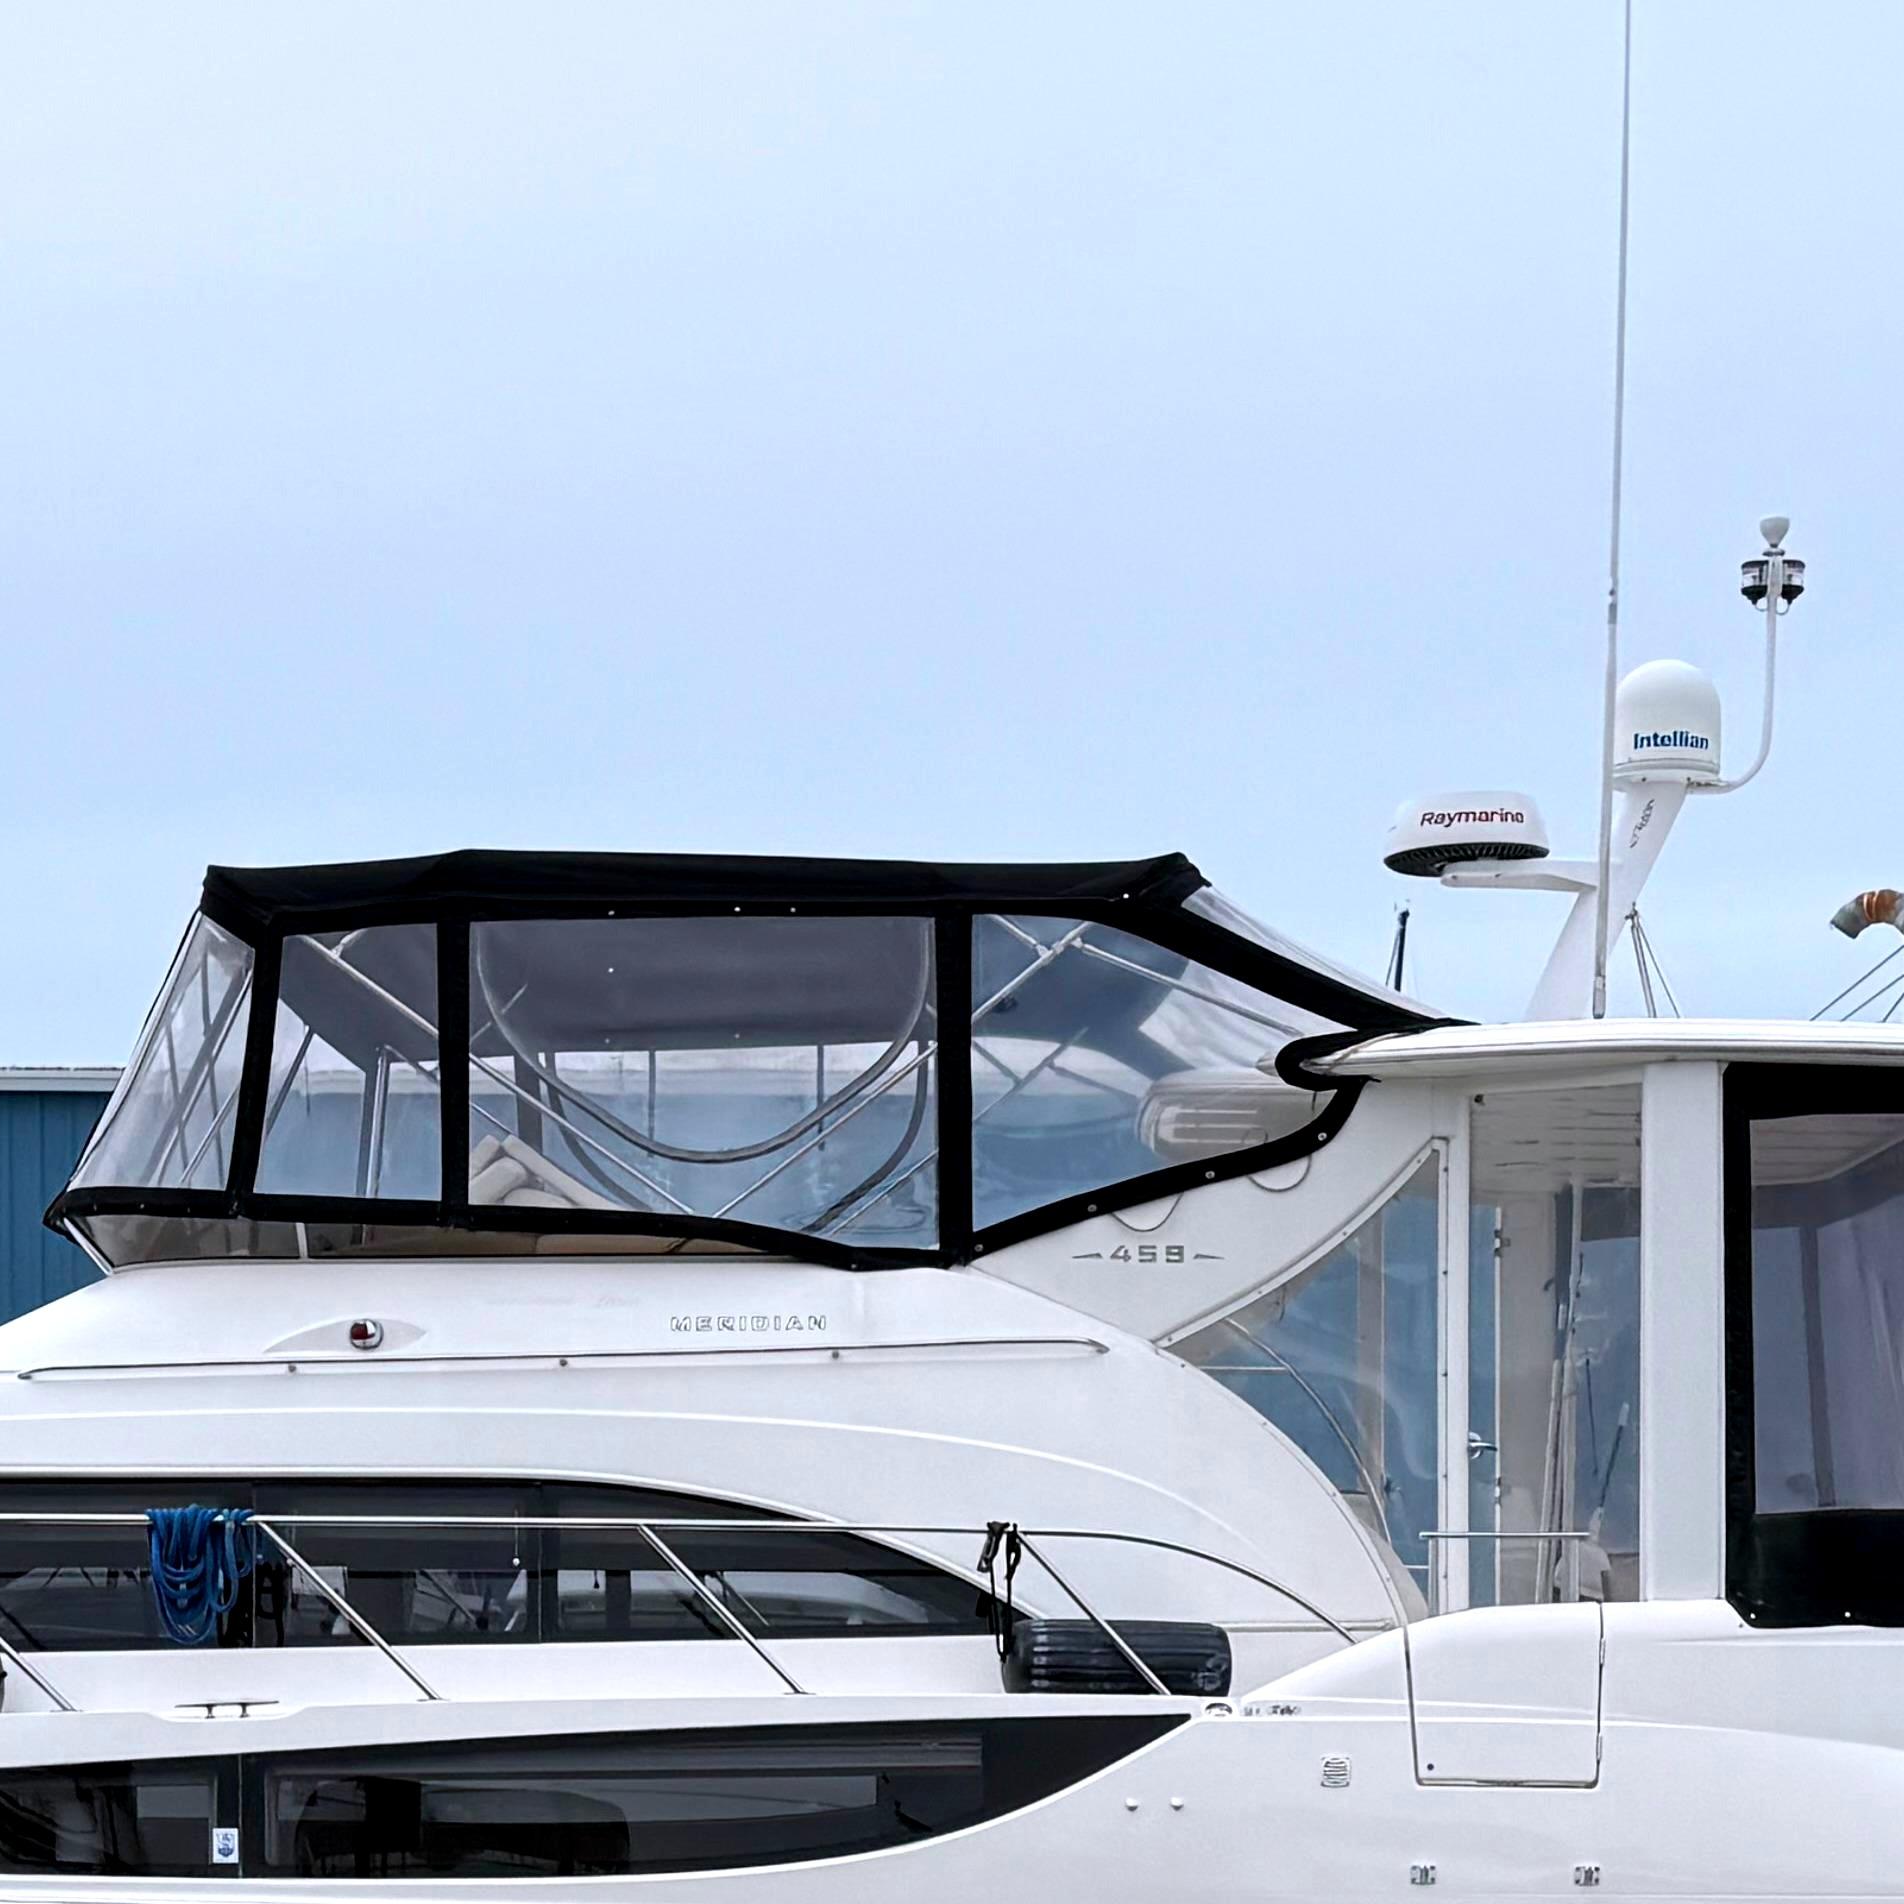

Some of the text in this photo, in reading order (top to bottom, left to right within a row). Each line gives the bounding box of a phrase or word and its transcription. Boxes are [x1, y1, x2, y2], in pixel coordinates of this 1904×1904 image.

[1633, 730, 1709, 750] Intellian
[1420, 808, 1524, 828] Raymarine
[1109, 1245, 1185, 1263] 459
[670, 1315, 827, 1332] MERIDIAN
